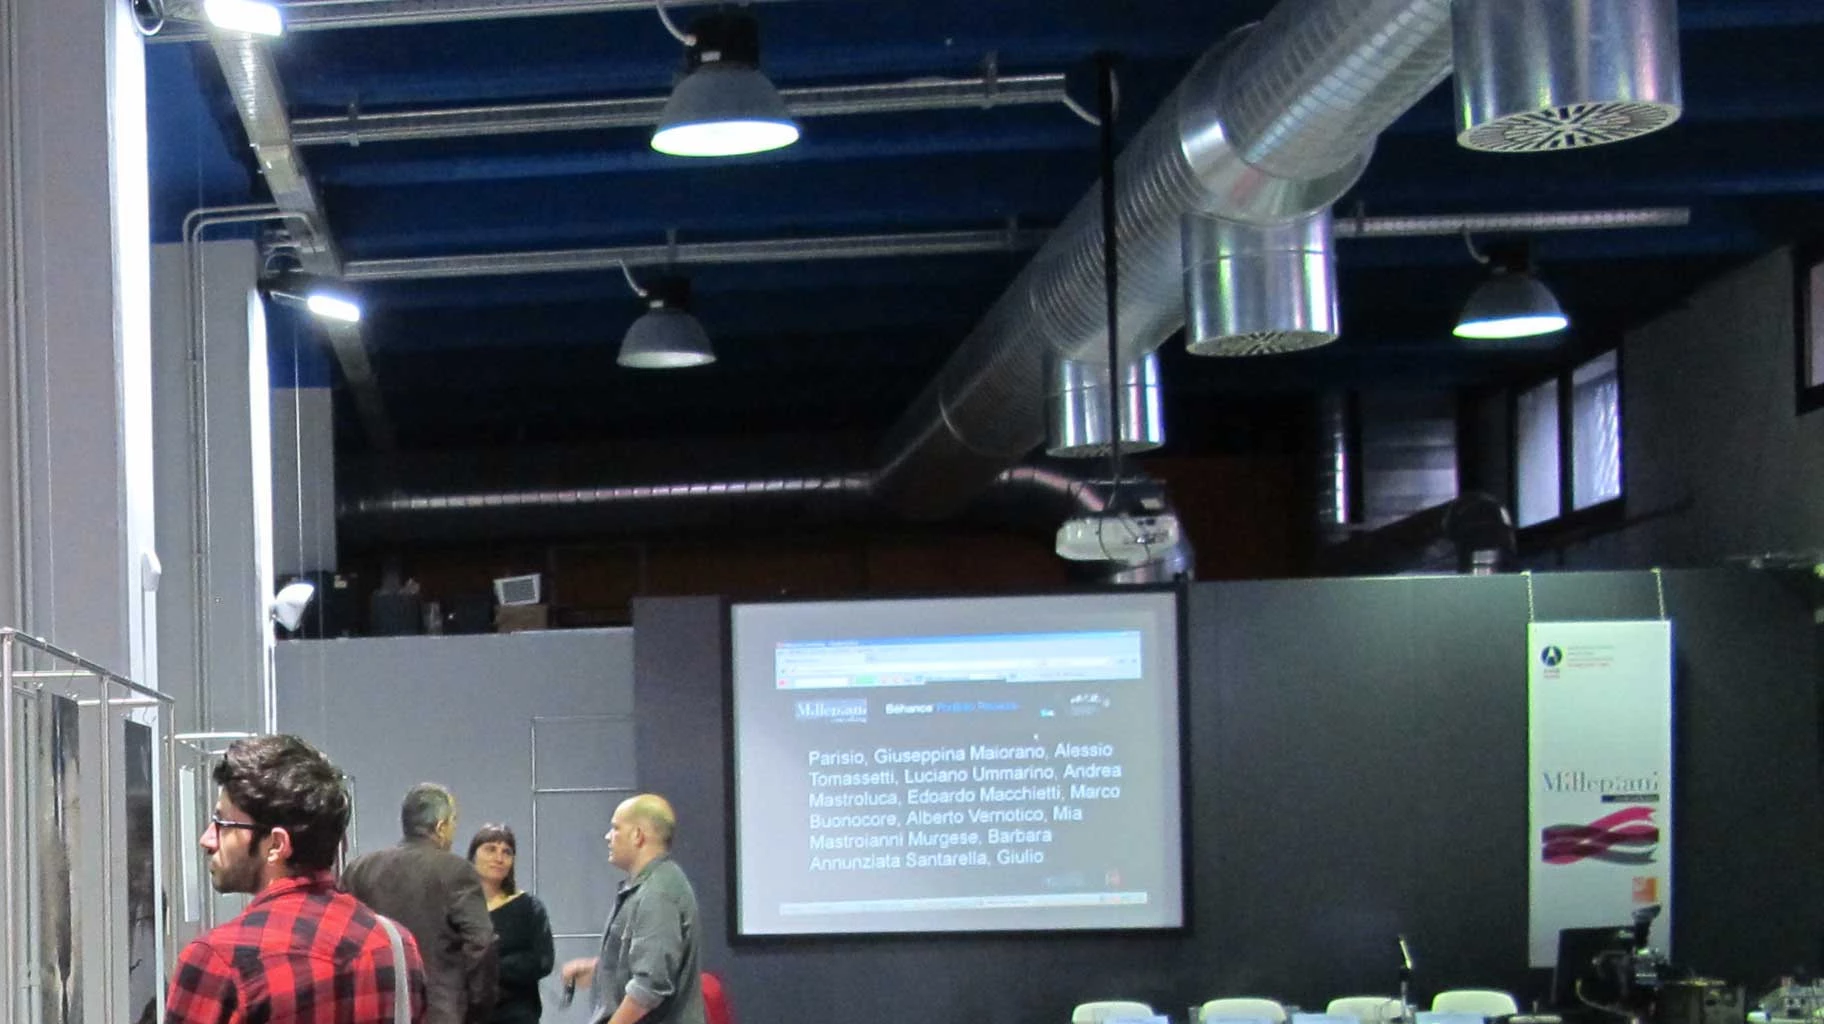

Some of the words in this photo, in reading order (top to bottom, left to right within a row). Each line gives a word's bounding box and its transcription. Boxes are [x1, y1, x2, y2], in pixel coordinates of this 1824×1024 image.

[808, 750, 868, 767] Parisio,
[874, 747, 965, 765] Giuseppina
[970, 745, 1049, 761] Maiorano,
[1054, 743, 1113, 758] Alessio
[808, 769, 899, 787] Tomassetti,
[904, 767, 968, 784] Luciano
[972, 765, 1058, 781] Ummarino,
[1063, 763, 1122, 779] Andrea
[1541, 771, 1659, 793] Millepiani
[808, 791, 902, 808] Mastroluca,
[907, 787, 975, 804] Edoardo
[980, 785, 1065, 802] Macchietti,
[1070, 784, 1121, 799] Marco
[809, 813, 901, 829] Buonocore,
[905, 810, 964, 825] Alberto
[1053, 806, 1083, 821] Mia
[809, 833, 904, 850] Mastroianni
[908, 831, 982, 848] Murgese,
[988, 828, 1052, 845] Barbara
[809, 854, 901, 872] Annunziata
[905, 851, 991, 868] Santarella,
[996, 849, 1044, 864] Giulio
